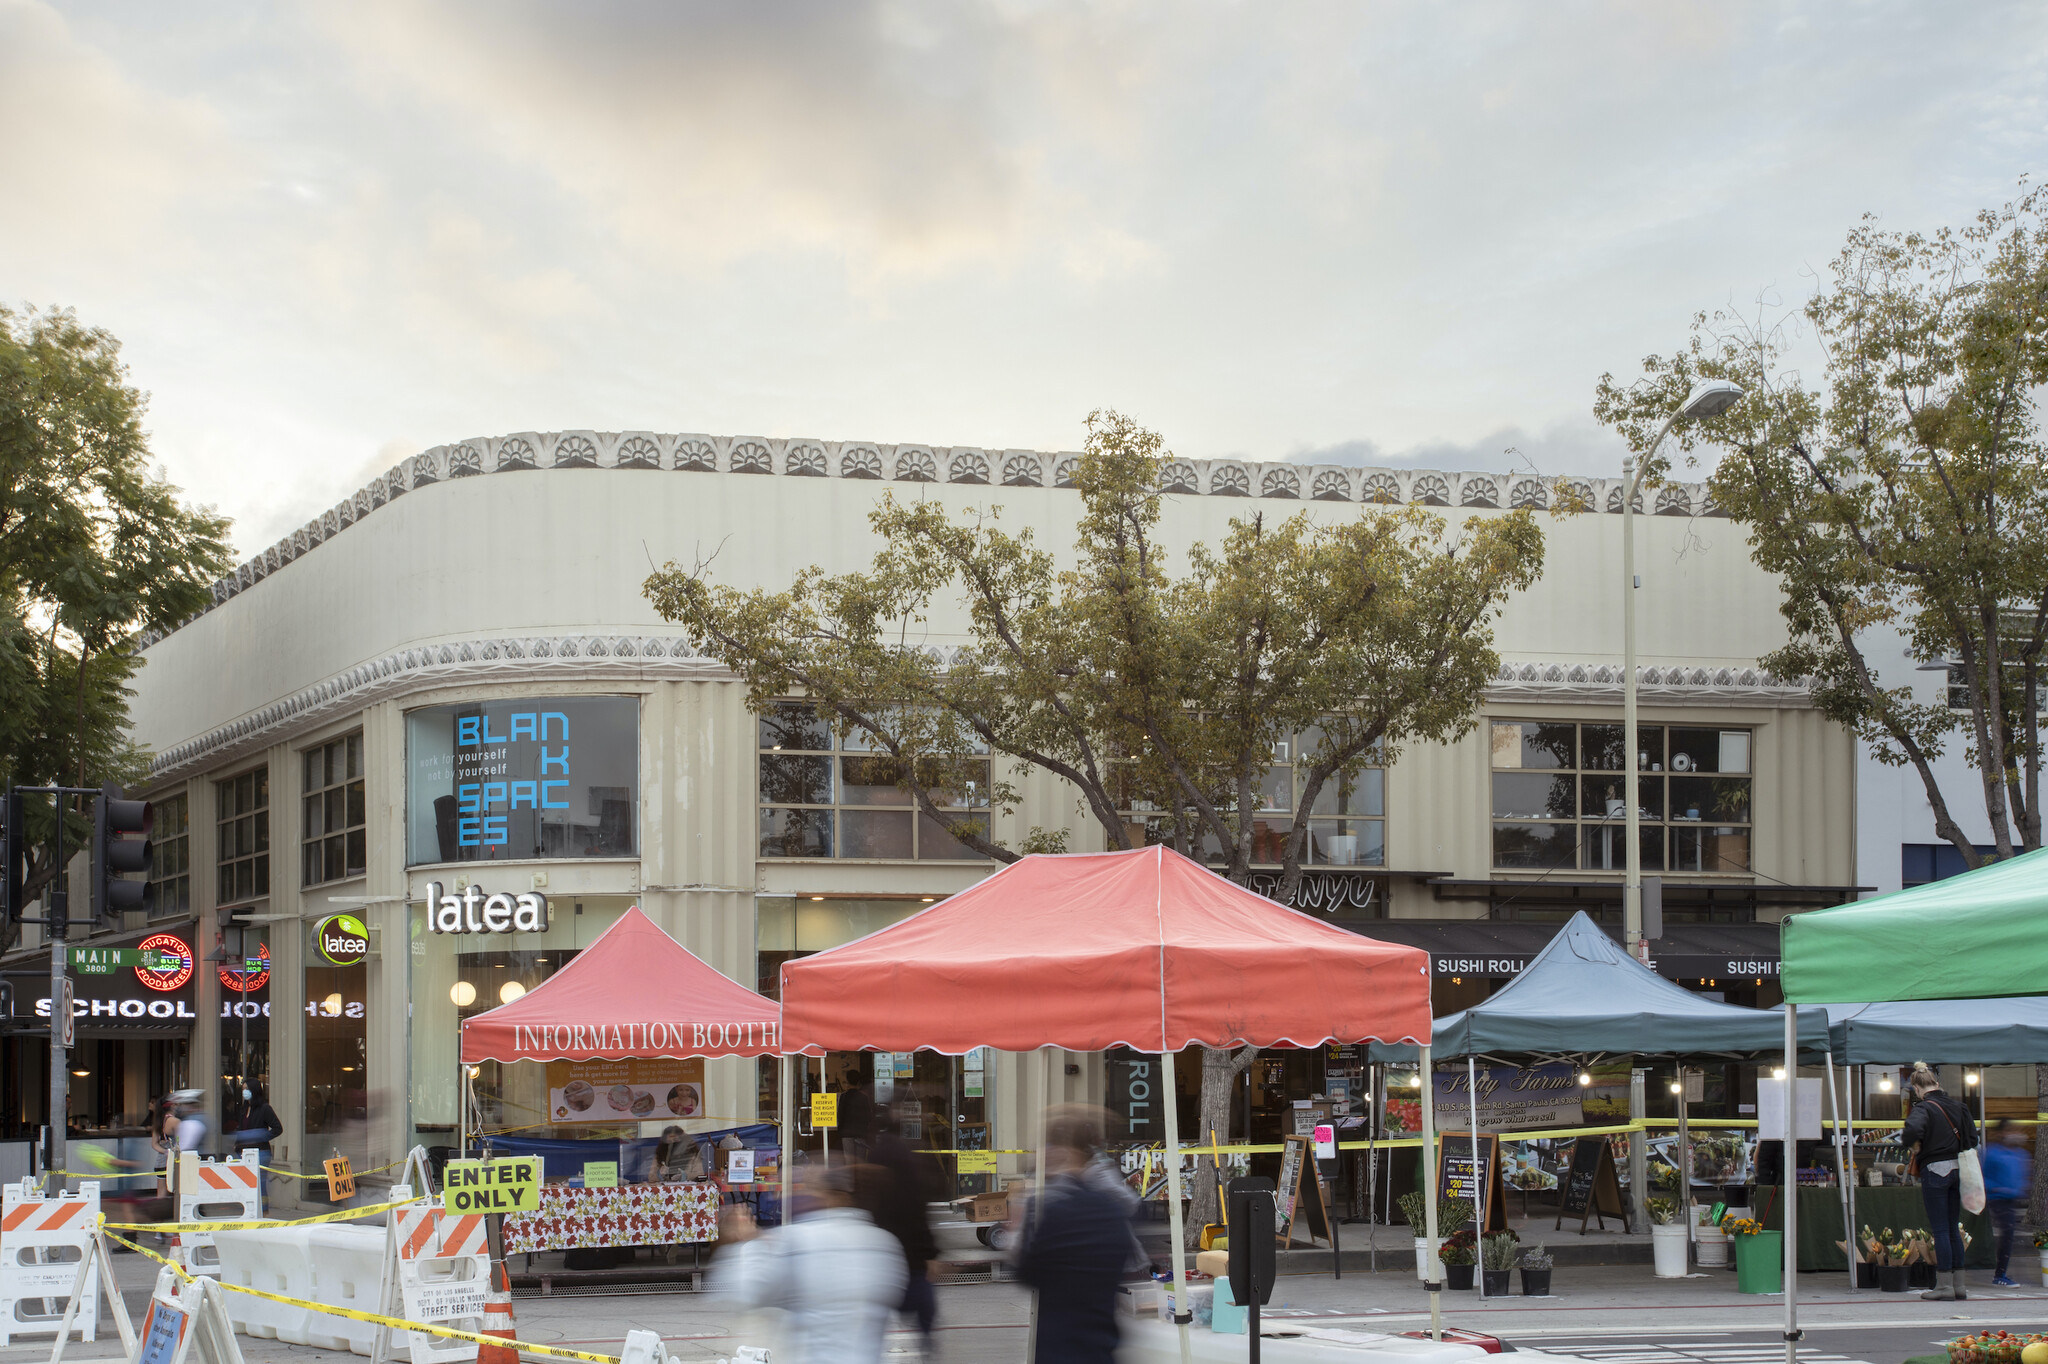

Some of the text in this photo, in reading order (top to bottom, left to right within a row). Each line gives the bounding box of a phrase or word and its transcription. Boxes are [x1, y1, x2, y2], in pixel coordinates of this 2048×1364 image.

[419, 748, 507, 768] work for yourself
[427, 763, 507, 782] not by yourself
[426, 882, 546, 932] latea
[324, 933, 366, 953] latea
[76, 950, 153, 964] MAIN ST
[85, 964, 107, 973] 3800
[1438, 959, 1484, 974] SUSHI
[1727, 960, 1772, 975] SUSHI
[514, 1021, 778, 1052] INFORMATION BOOTH
[1509, 1067, 1577, 1092] Farms
[1128, 1060, 1150, 1134] ROLL
[1436, 1103, 1450, 1112] 410
[1451, 1103, 1458, 1111] S.
[1459, 1101, 1491, 1112] Becwith
[1492, 1101, 1503, 1110] Rd.
[1506, 1100, 1526, 1109] Santa
[1528, 1099, 1549, 1108] Paula
[1549, 1098, 1560, 1106] CA
[1480, 1116, 1503, 1127] grow
[1503, 1114, 1526, 1124] what
[333, 1160, 351, 1177] EXIT
[448, 1164, 533, 1188] ENTER
[335, 1179, 355, 1195] ONLY
[1450, 1179, 1462, 1188] $20
[455, 1188, 526, 1210] ONLY
[1446, 1189, 1458, 1198] $24
[454, 1286, 475, 1294] ANGELES
[436, 1297, 443, 1305] OF
[445, 1296, 465, 1304] PUBLIC
[421, 1302, 484, 1318] STREET SERVICES
